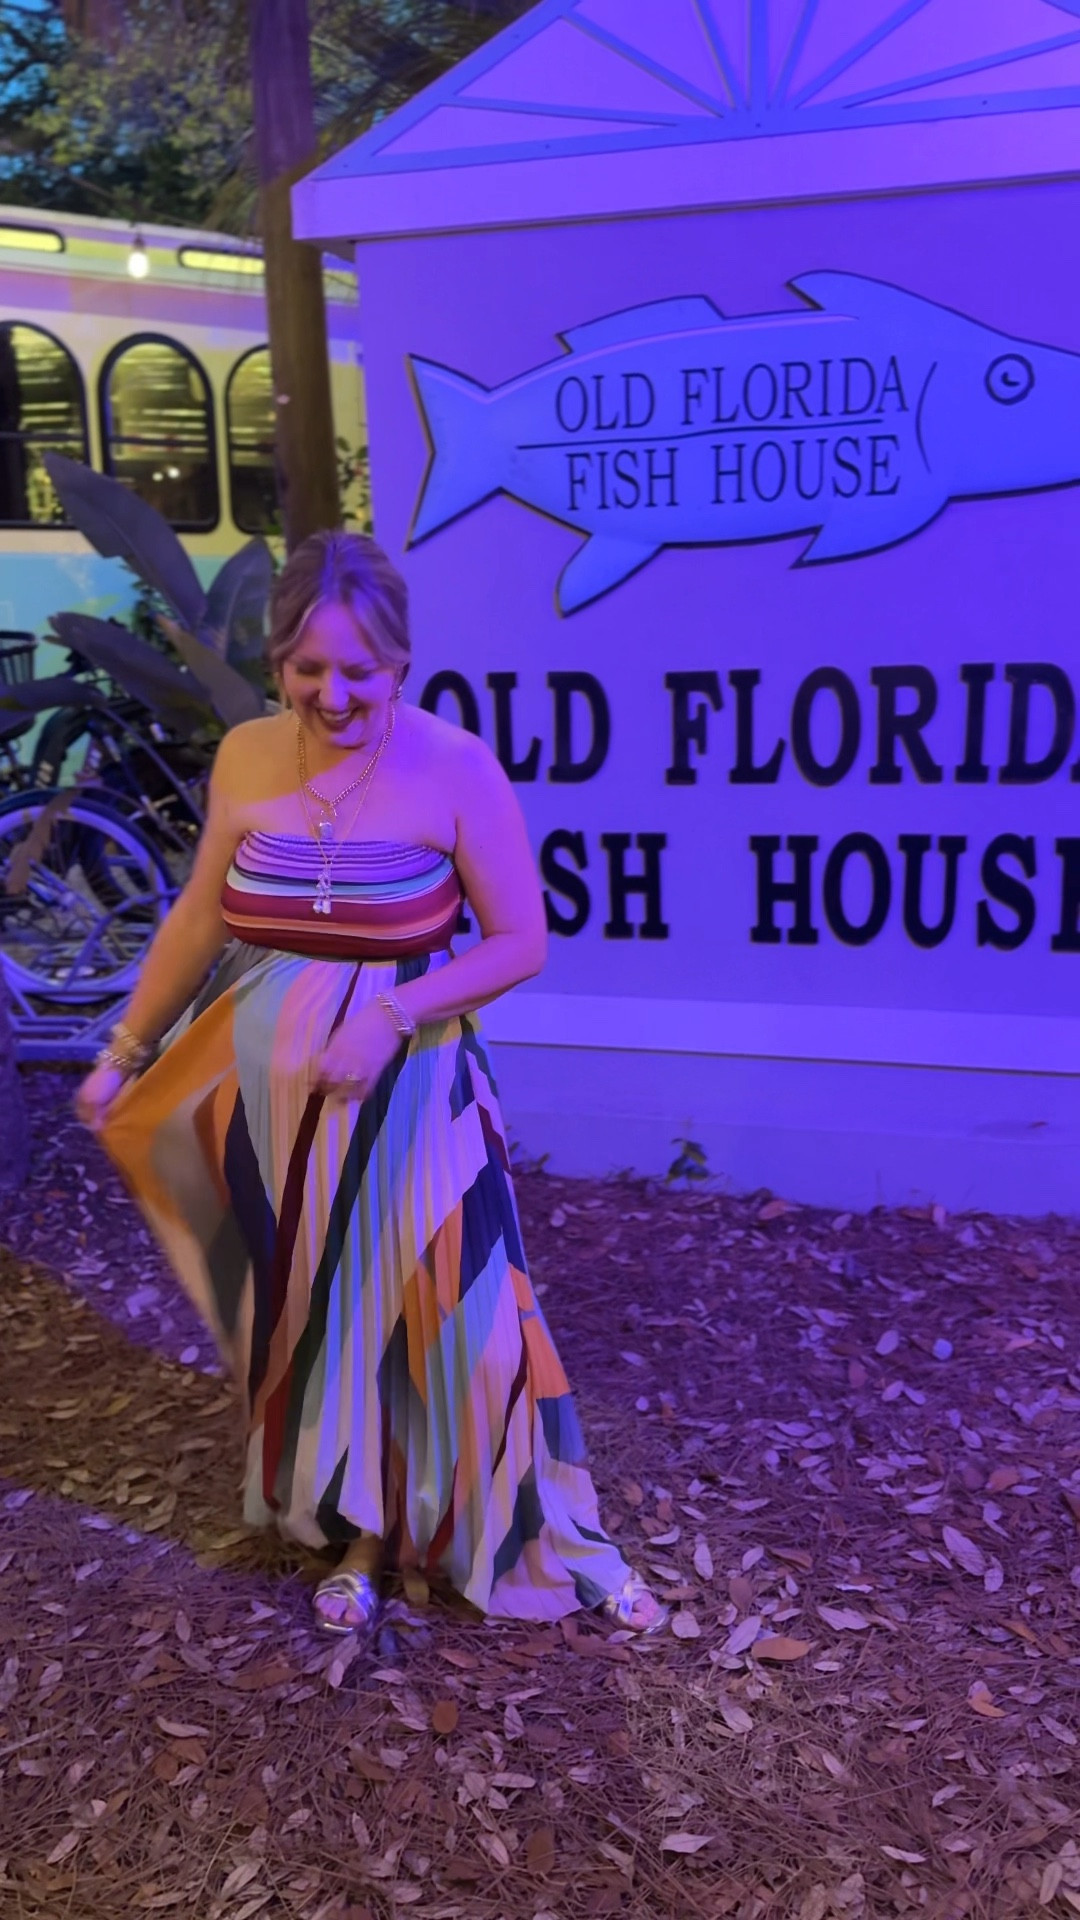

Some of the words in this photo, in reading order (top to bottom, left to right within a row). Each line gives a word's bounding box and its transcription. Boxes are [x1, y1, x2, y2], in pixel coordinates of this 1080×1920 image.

[555, 372, 655, 433] OLD
[680, 355, 909, 425] FLORIDA
[565, 447, 679, 511] FISH
[710, 434, 901, 503] HOUSE
[665, 662, 1080, 787] FLORID
[455, 828, 669, 940] SH
